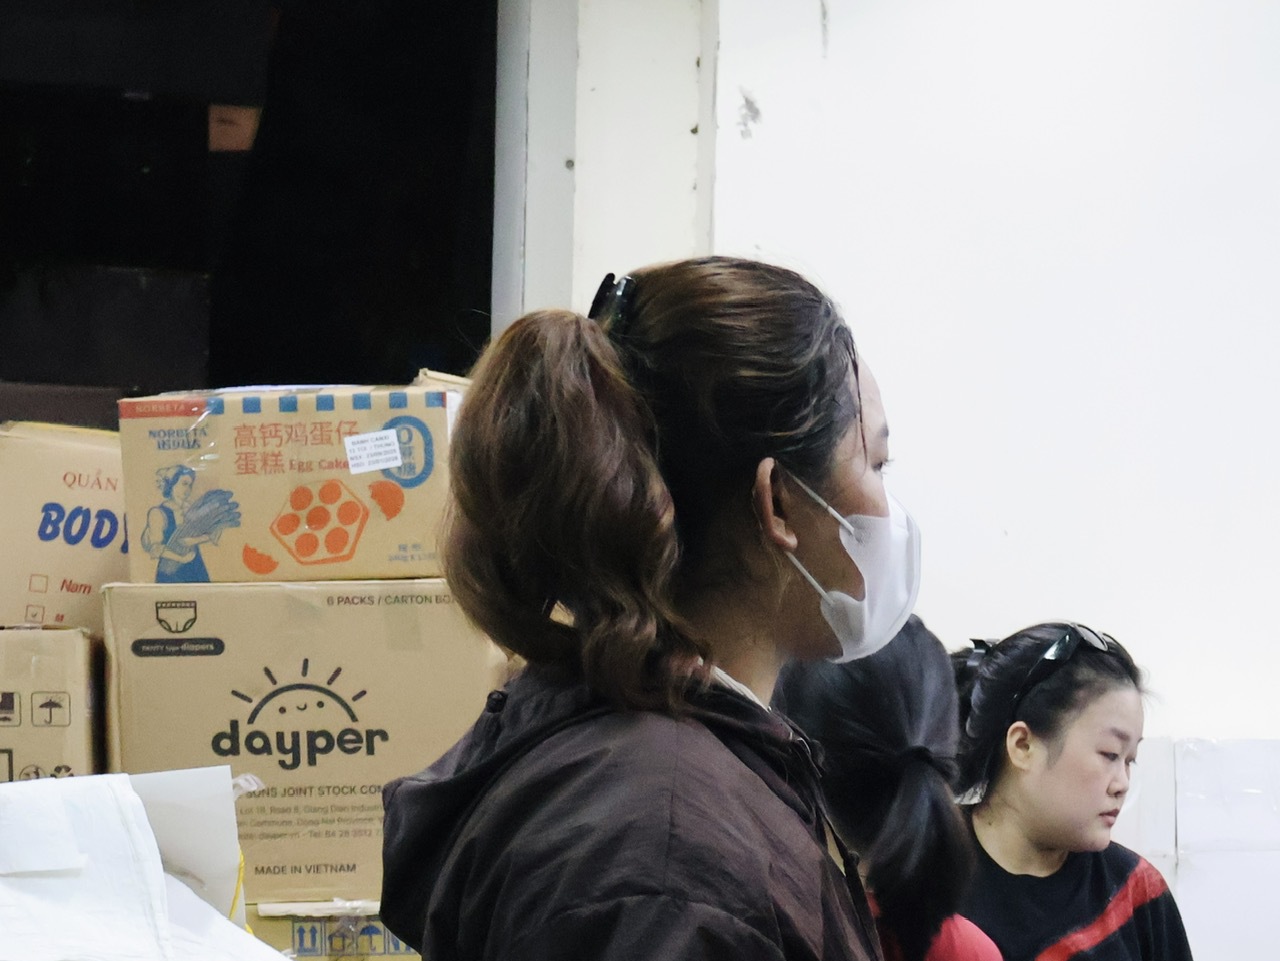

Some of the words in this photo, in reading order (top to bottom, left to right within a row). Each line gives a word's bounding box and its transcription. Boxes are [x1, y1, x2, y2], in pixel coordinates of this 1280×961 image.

[234, 451, 285, 475] 蛋糕
[289, 459, 314, 473] Egg
[37, 501, 129, 555] BOD
[60, 579, 92, 595] Nam
[337, 596, 375, 606] PACKS
[384, 594, 432, 606] CARTON
[211, 719, 389, 770] dayper
[282, 786, 314, 798] JOINT
[318, 785, 355, 796] STOCK
[254, 865, 288, 875] MADE
[291, 864, 302, 874] IN
[305, 863, 357, 874] VIETNAM
